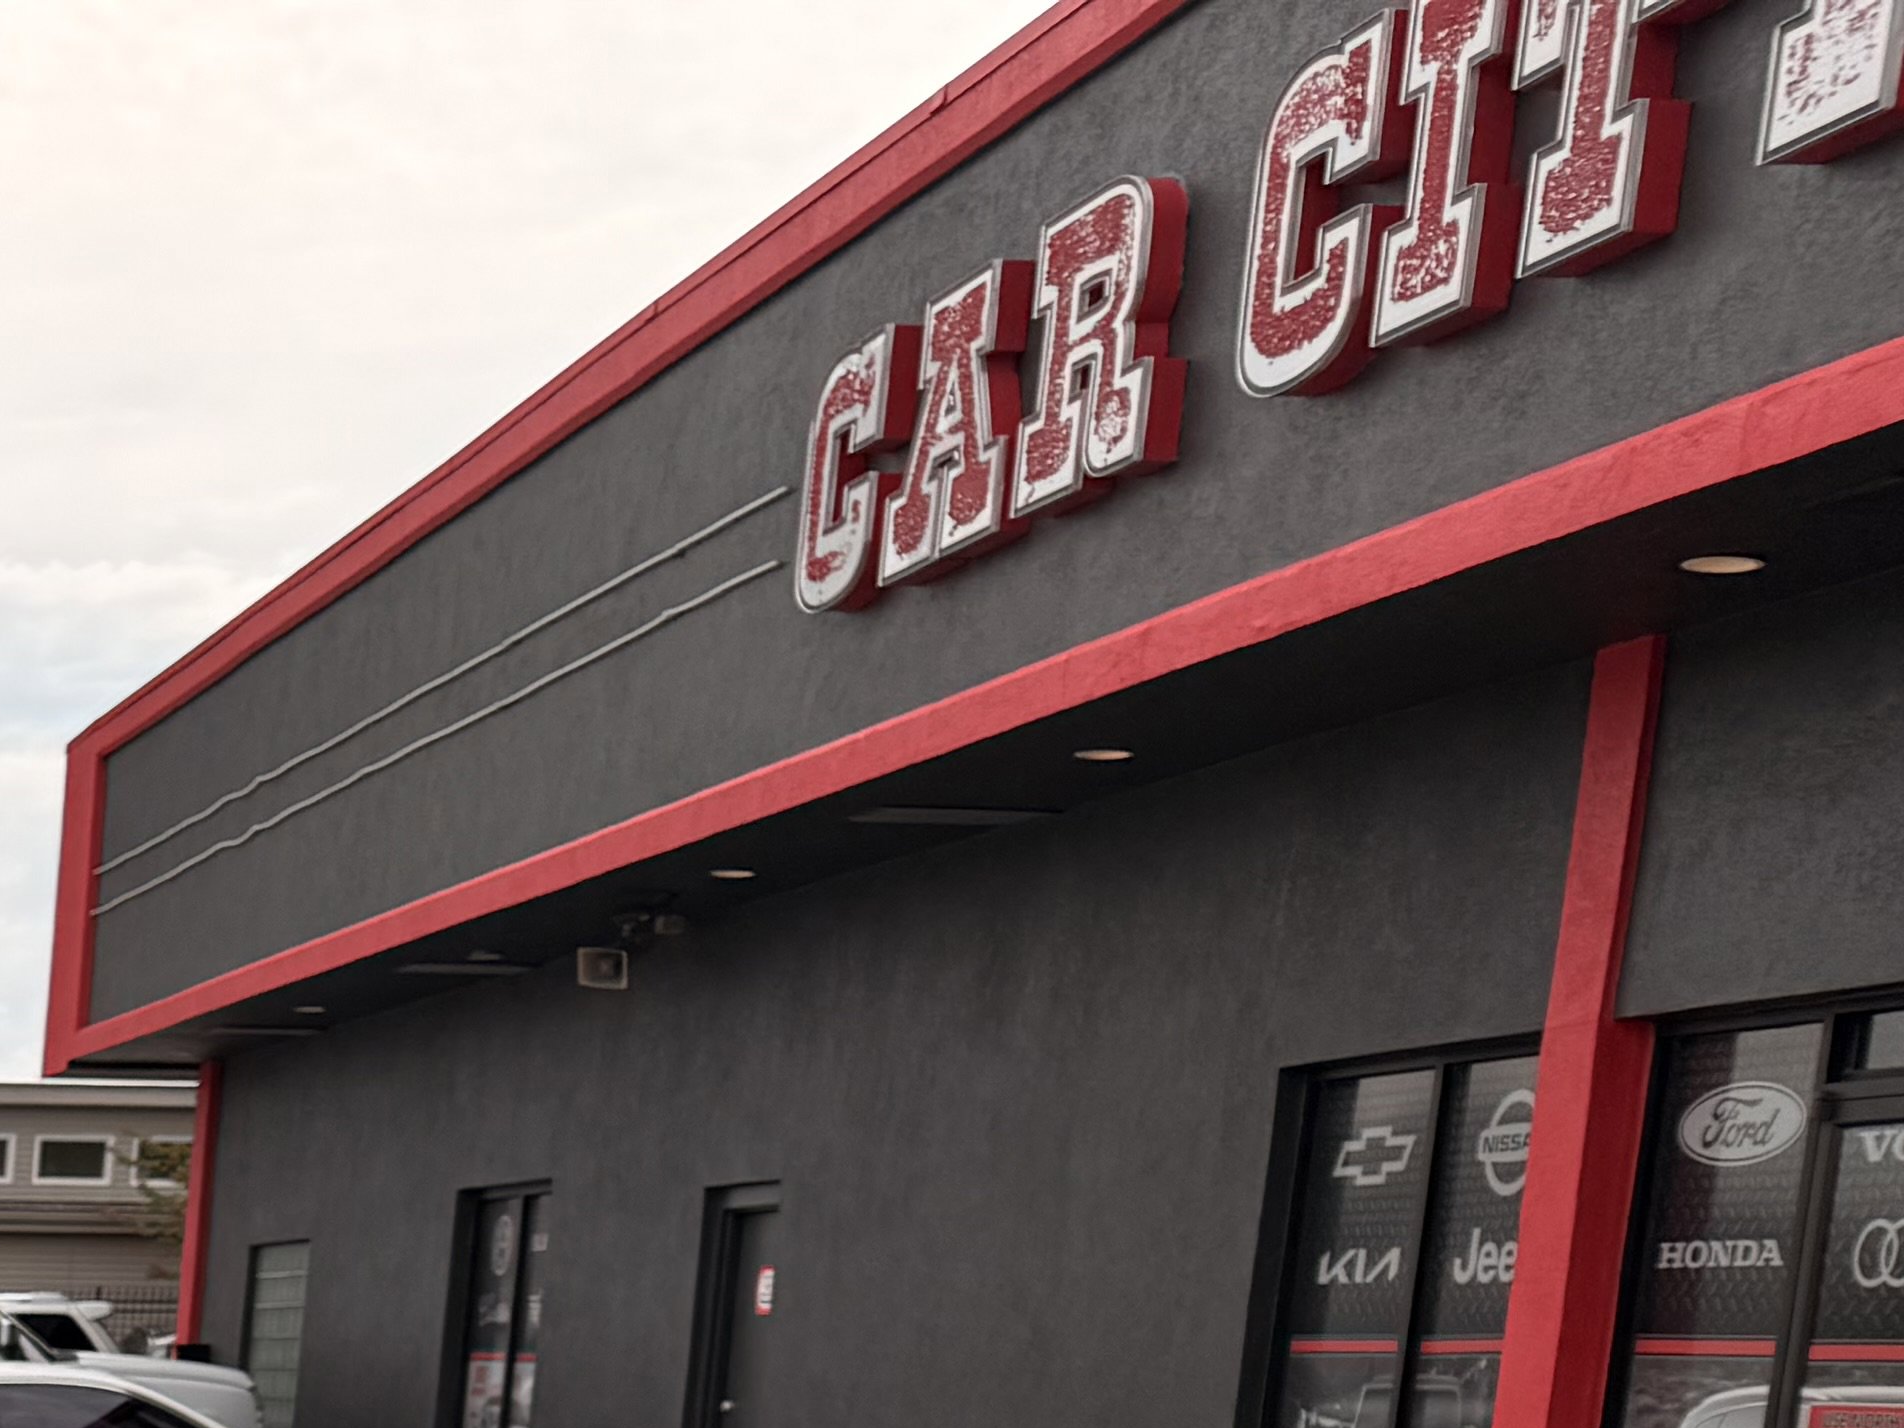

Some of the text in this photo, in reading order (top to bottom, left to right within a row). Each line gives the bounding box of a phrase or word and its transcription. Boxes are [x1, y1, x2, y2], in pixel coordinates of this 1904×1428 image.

[796, 0, 1904, 614] CAR CIT
[1482, 1133, 1532, 1153] NISS
[1702, 1096, 1781, 1149] Ford
[1317, 1246, 1402, 1286] KIA
[1452, 1226, 1519, 1285] Jee
[1657, 1238, 1785, 1270] HONDA
